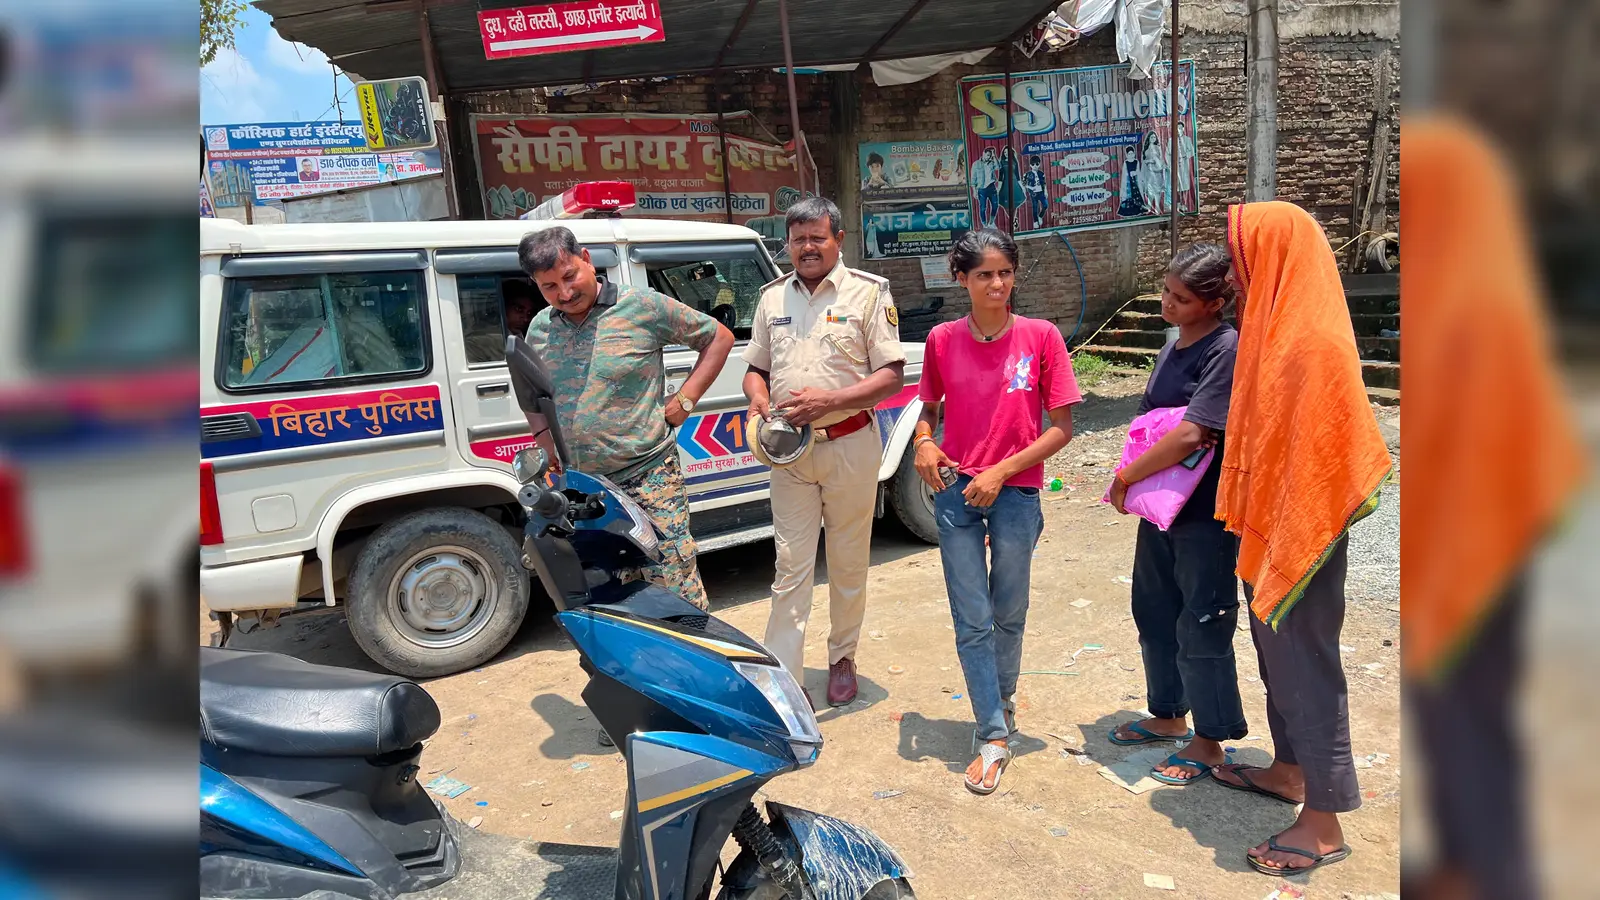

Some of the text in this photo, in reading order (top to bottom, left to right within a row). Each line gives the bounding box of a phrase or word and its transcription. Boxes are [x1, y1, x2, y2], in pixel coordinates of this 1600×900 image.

[507, 10, 527, 32] दही
[528, 8, 562, 31] लस्सी,
[969, 80, 1056, 139] SS
[287, 124, 313, 138] हार्ट
[314, 123, 365, 139] इंस्टीट्यू
[1109, 136, 1123, 144] Petrol
[492, 125, 589, 174] सैफी
[595, 135, 691, 173] टायर
[891, 143, 954, 153] Bombay Bakery
[336, 156, 359, 168] दीपक
[361, 154, 377, 166] वर्मा
[1068, 172, 1105, 185] Ladies Wear
[639, 193, 766, 212] थोक एवं खुदरा विक्रेता
[1070, 191, 1105, 203] Kids Wear
[873, 211, 915, 231] राज
[268, 392, 436, 437] बिहार पुलिस
[686, 454, 756, 473] आपकी सुरक्षा, हमा
